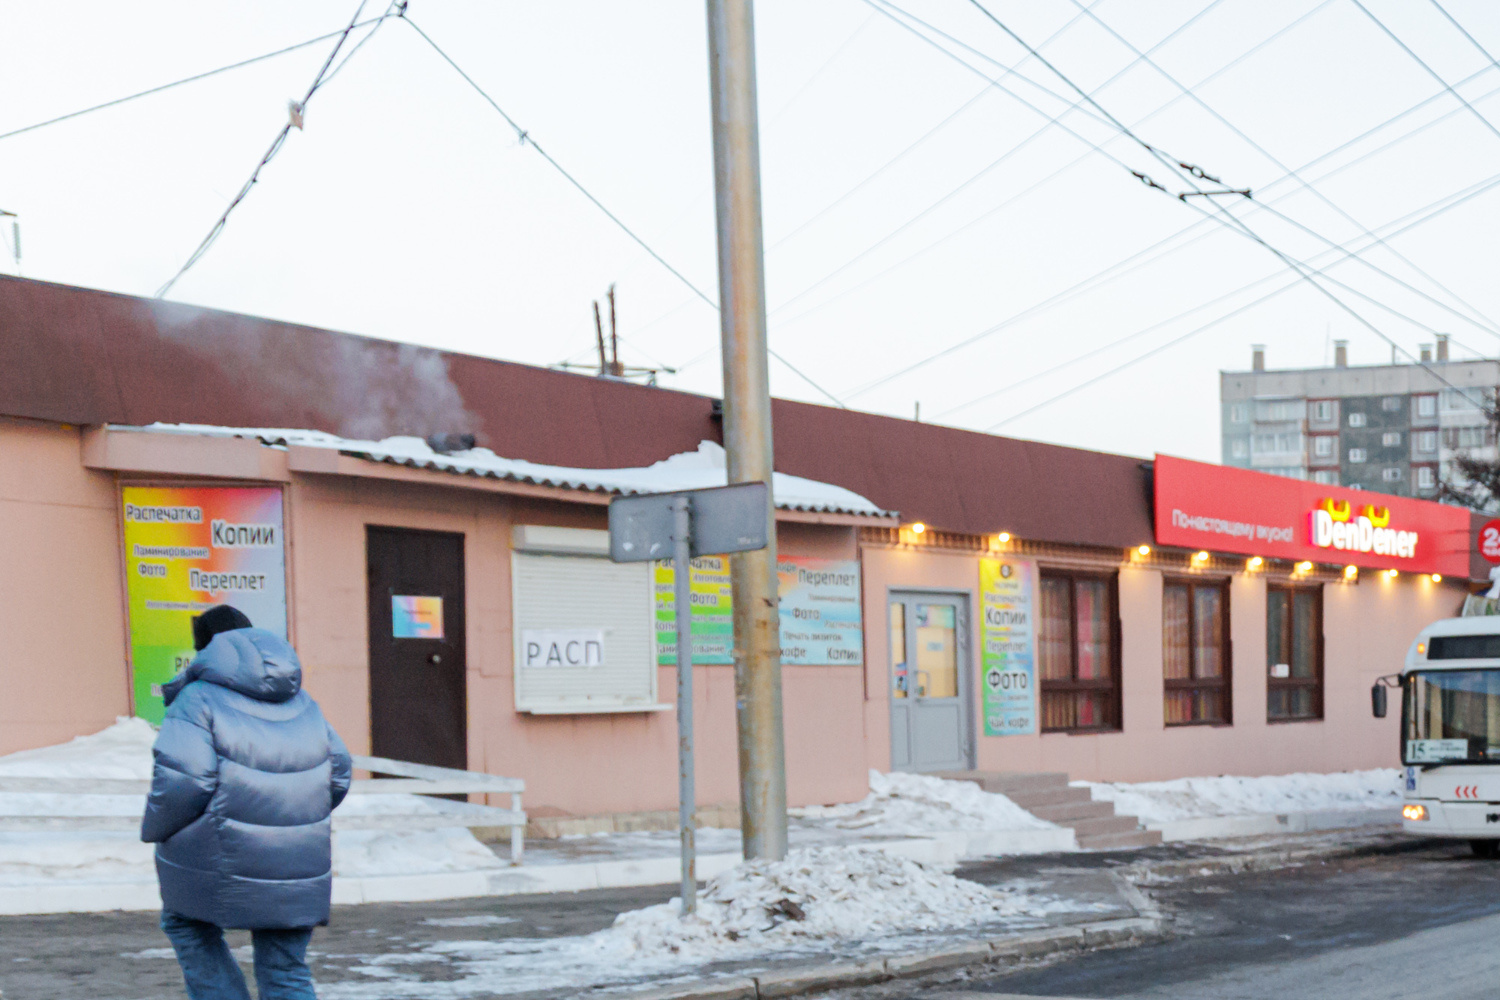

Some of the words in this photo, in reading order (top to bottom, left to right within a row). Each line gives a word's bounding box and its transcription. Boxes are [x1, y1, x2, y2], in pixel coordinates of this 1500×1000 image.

[126, 504, 202, 521] Распечатка
[213, 521, 274, 545] Копии
[1315, 509, 1418, 558] DenDener
[134, 545, 208, 560] Ламинирование
[138, 563, 166, 576] Фото
[799, 568, 856, 587] Переплет
[190, 570, 265, 594] Переплет
[689, 594, 717, 605] Фото
[792, 608, 820, 619] Фото
[986, 607, 1027, 625] Копии
[527, 640, 601, 666] РАСП
[988, 669, 1027, 689] Фото
